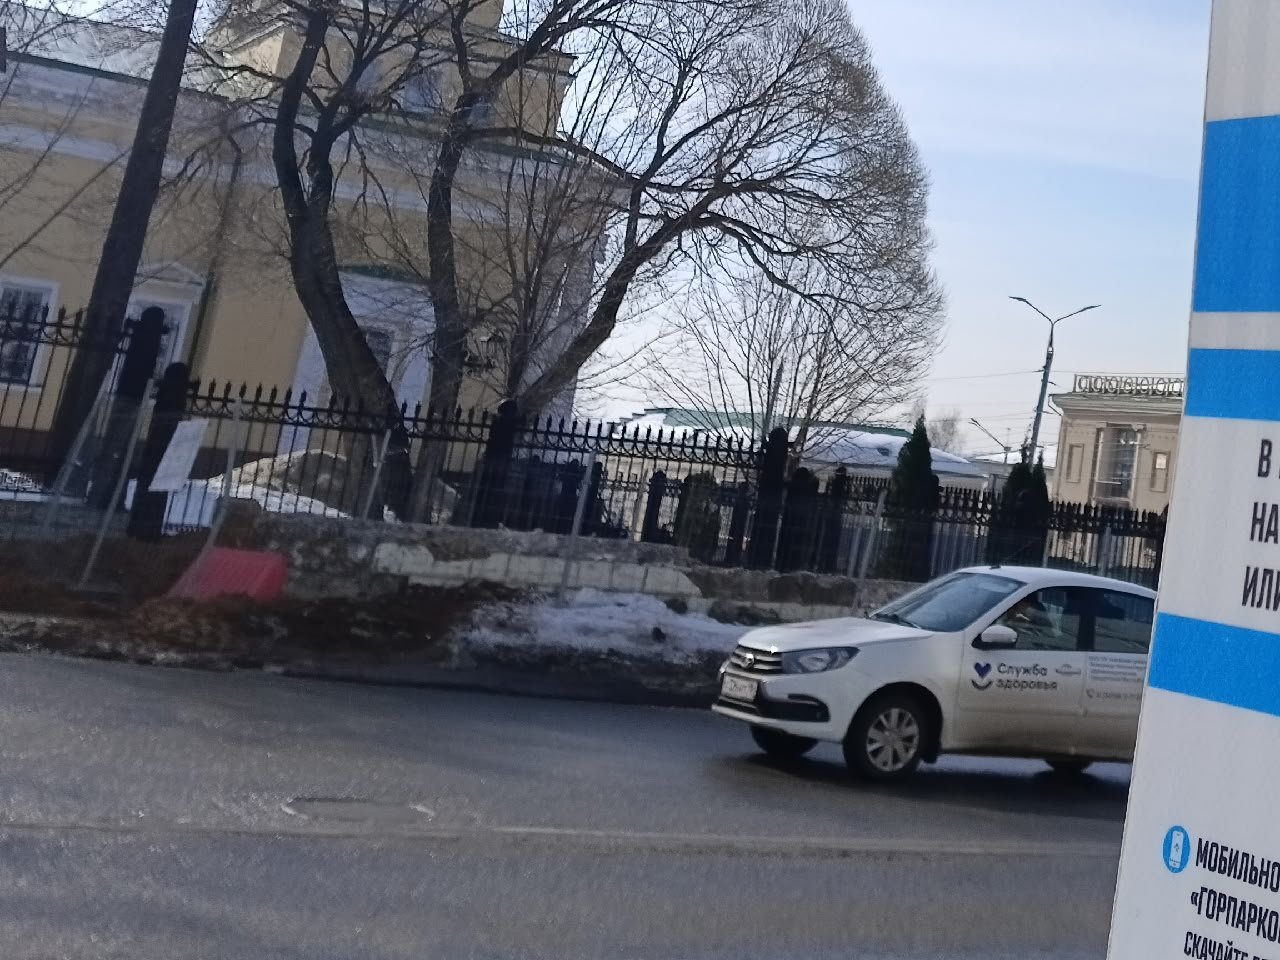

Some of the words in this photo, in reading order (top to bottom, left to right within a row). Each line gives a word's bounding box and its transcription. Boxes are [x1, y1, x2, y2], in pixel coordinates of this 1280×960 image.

[1257, 438, 1273, 478] В
[1249, 501, 1279, 545] НА
[997, 662, 1048, 678] Служба
